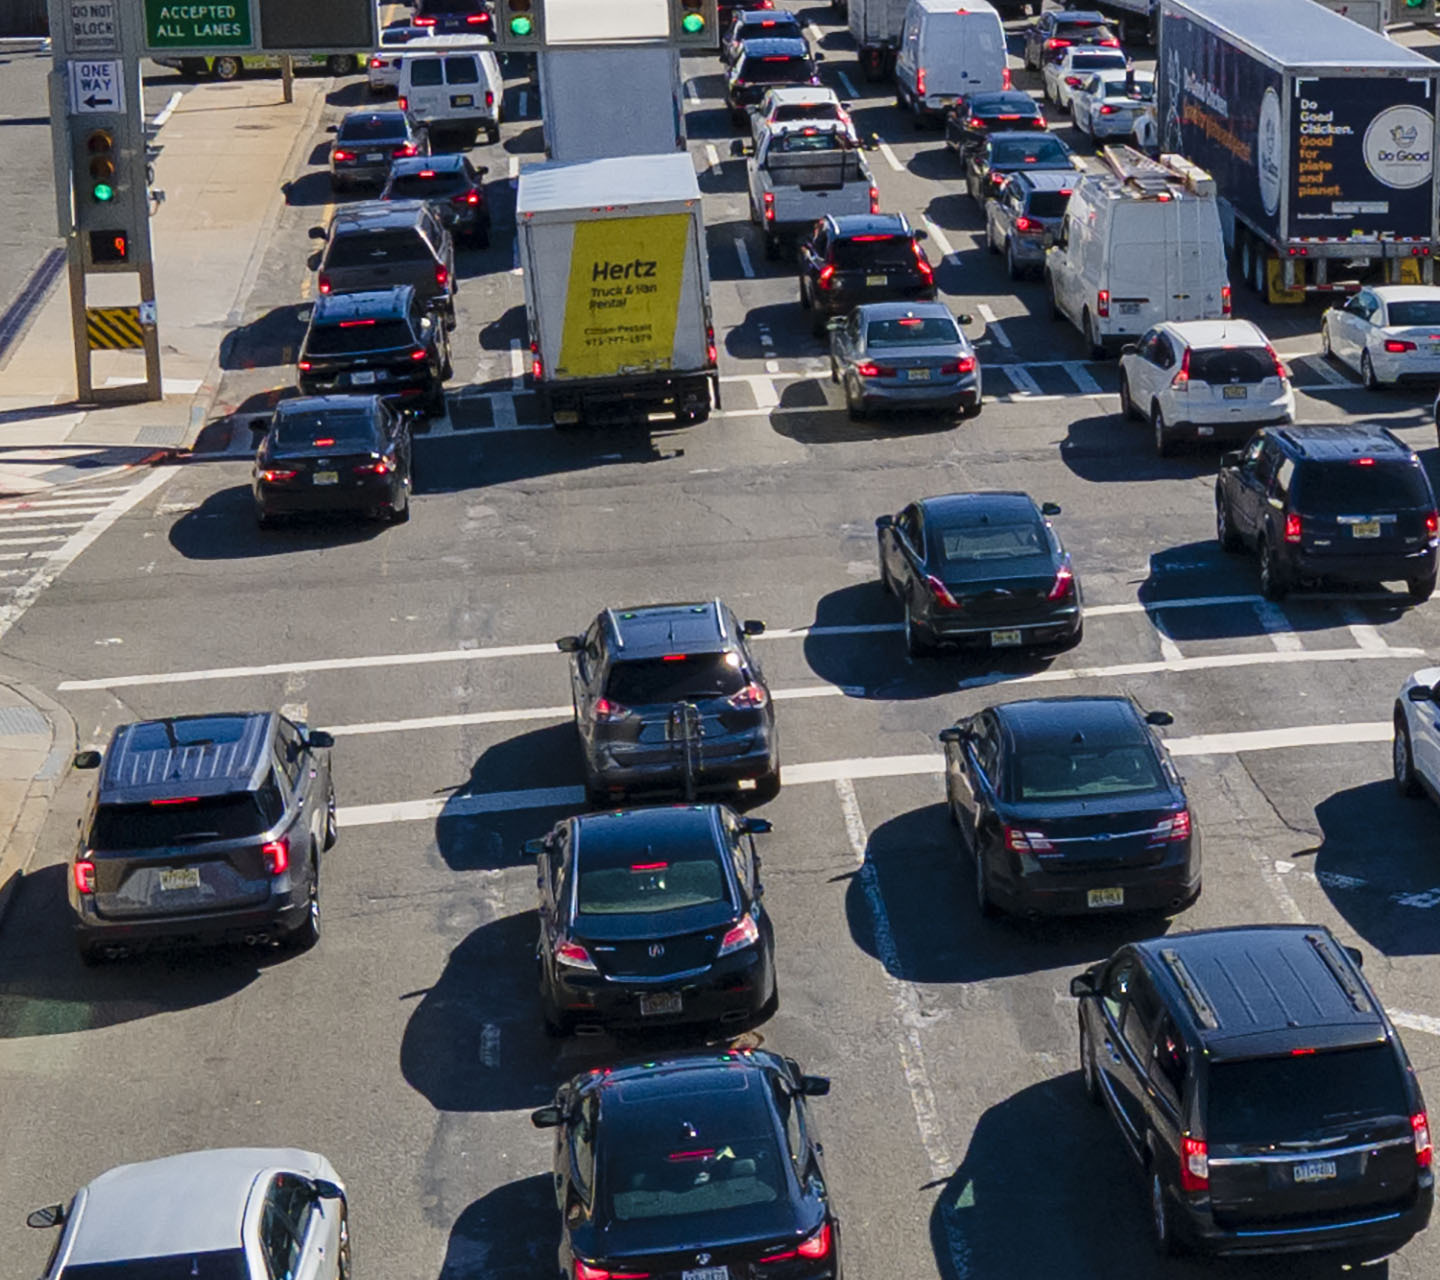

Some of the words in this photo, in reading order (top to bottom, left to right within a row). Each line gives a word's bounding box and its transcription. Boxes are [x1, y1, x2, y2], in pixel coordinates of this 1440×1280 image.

[72, 5, 88, 18] DO
[90, 4, 112, 18] NOT
[160, 6, 236, 20] ACCEPTED
[74, 22, 113, 35] BLOCK
[157, 23, 186, 38] ALL
[194, 22, 242, 37] LANES
[81, 65, 110, 77] ONE
[81, 78, 111, 91] WAY
[1300, 99, 1318, 110] Do
[1300, 110, 1333, 122] Good
[1299, 122, 1354, 135] Chicken.
[1299, 135, 1333, 147] Good
[1299, 148, 1319, 159] for
[1378, 150, 1394, 161] Do
[1396, 150, 1430, 162] Good
[1299, 161, 1333, 172] plate
[1298, 172, 1324, 183] and
[115, 237, 125, 256] 9
[592, 258, 657, 282] Hertz
[592, 286, 624, 298] Truck
